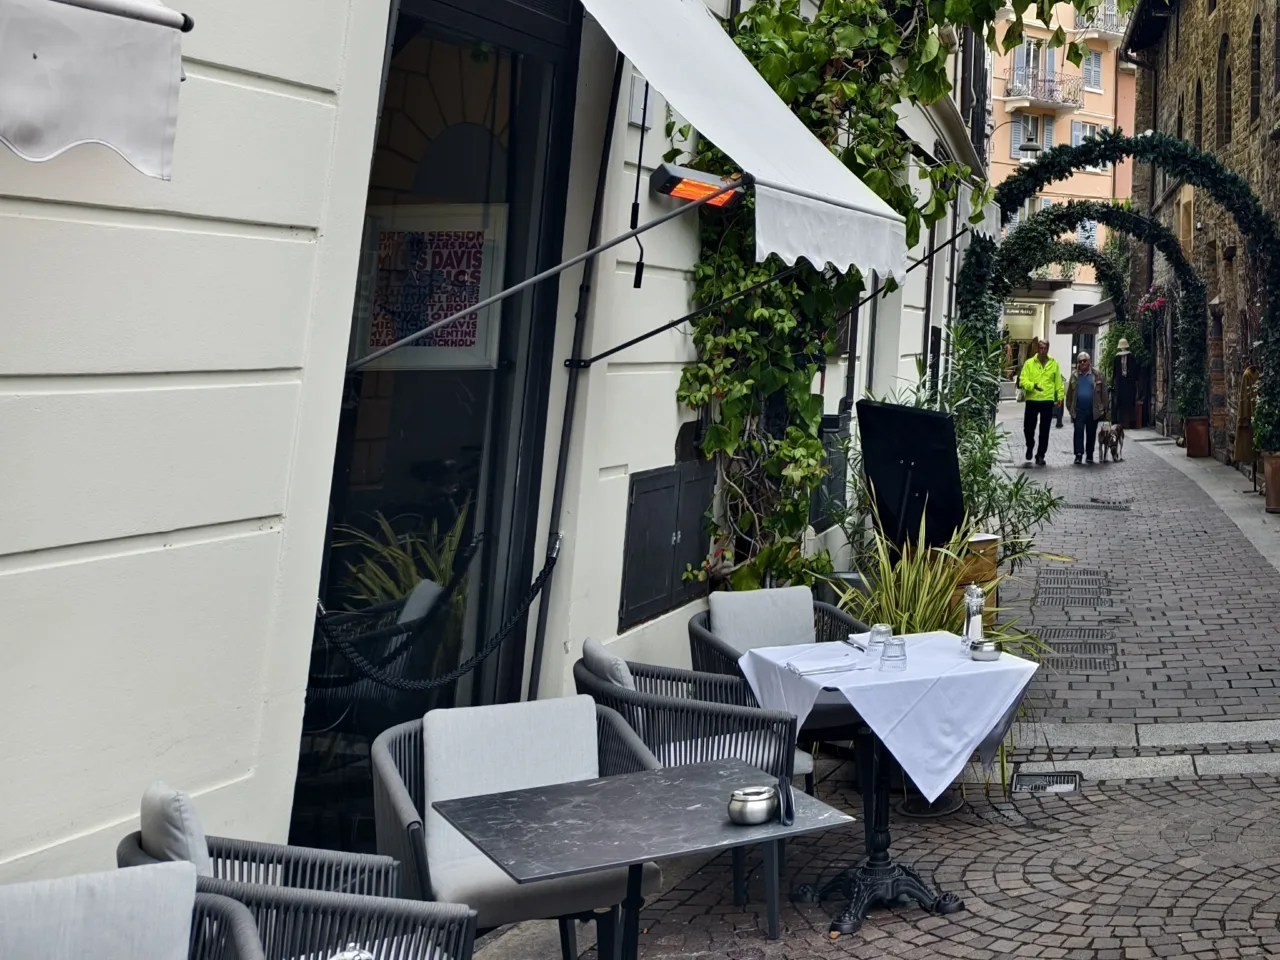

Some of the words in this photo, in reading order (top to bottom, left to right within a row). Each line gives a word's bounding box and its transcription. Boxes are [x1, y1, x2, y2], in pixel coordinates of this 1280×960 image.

[428, 231, 484, 241] SESSION
[458, 241, 484, 250] PLAY
[378, 251, 428, 270] MILES
[431, 250, 483, 270] DAVIS
[376, 270, 481, 287] CLASSICS
